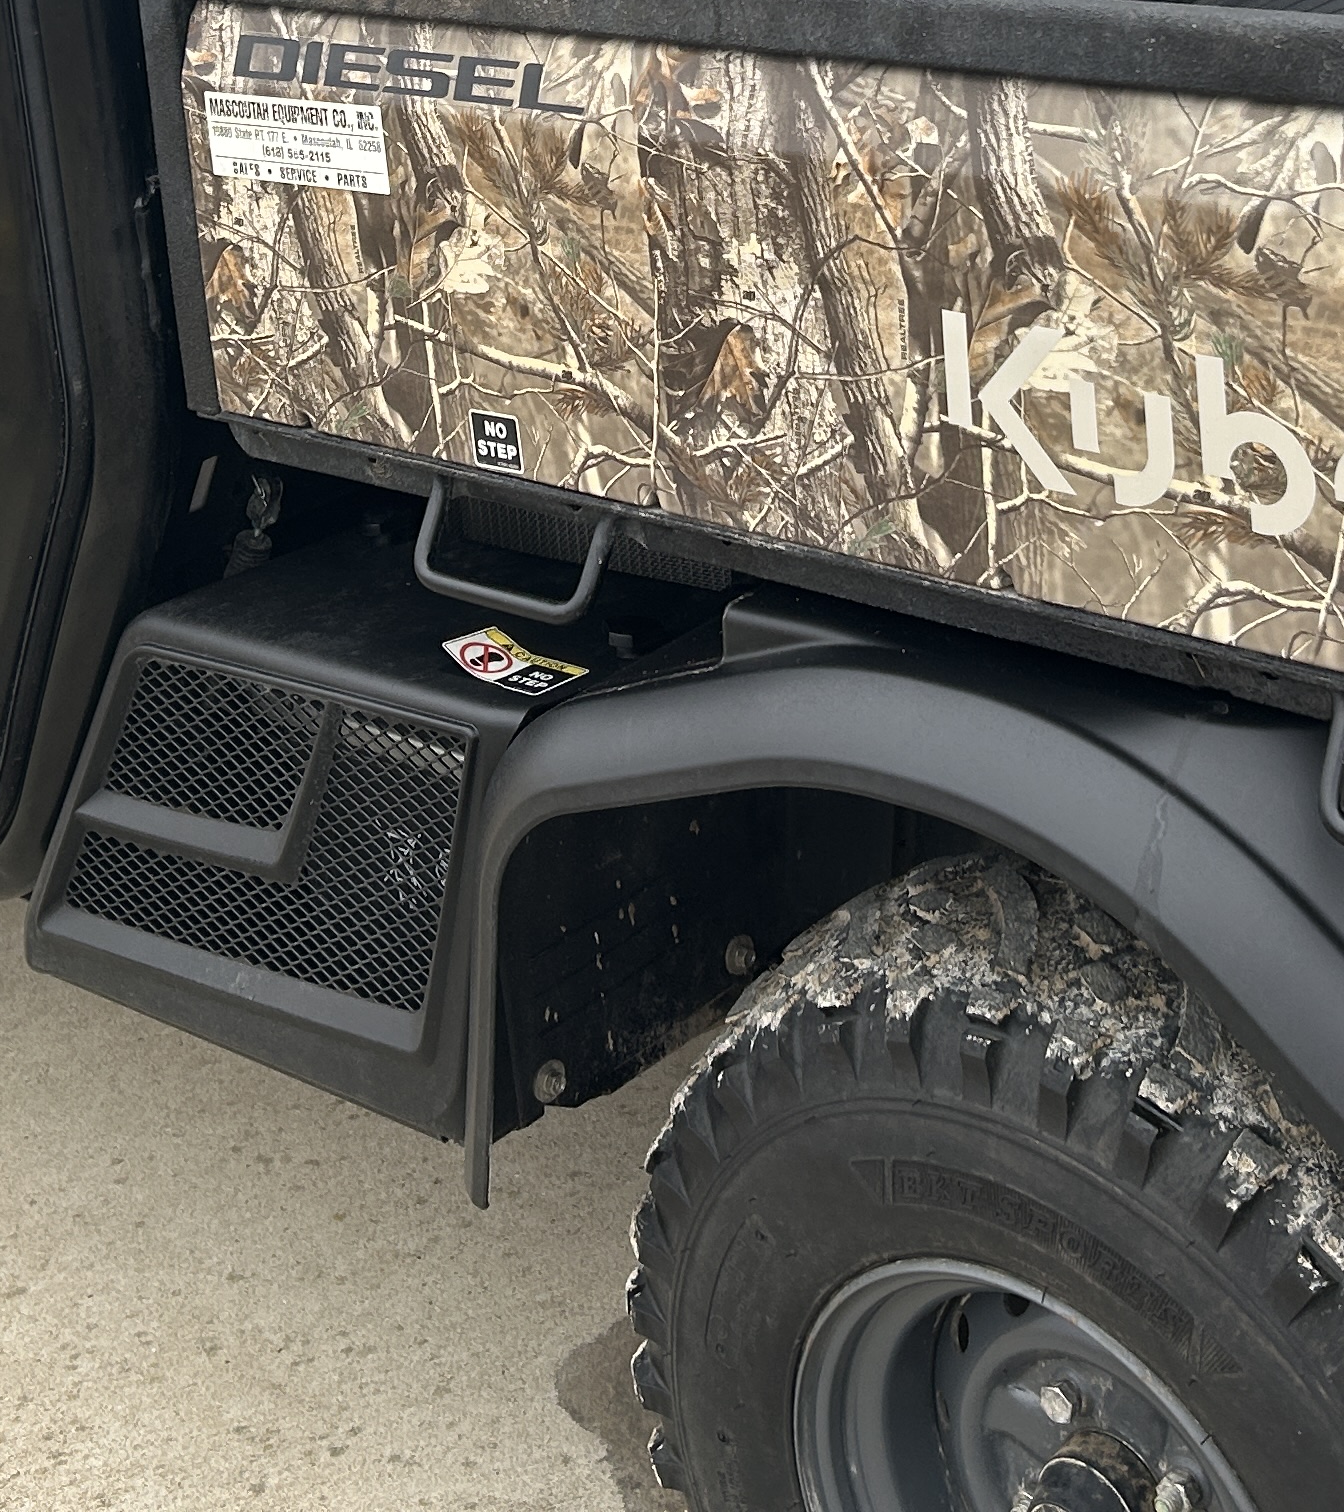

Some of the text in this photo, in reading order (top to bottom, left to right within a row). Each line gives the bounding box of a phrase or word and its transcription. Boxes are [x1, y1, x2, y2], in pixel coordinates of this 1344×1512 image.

[233, 34, 585, 116] DIESEL
[209, 97, 269, 121] MASCOUTAH
[272, 103, 329, 127] EQUIPMENT
[232, 161, 368, 188] SALES SERVICE PARTS
[897, 298, 907, 360] REALTREE
[483, 419, 507, 439] NO
[477, 439, 517, 461] STEP
[515, 651, 567, 670] CAUTION
[508, 674, 548, 688] STEP
[528, 670, 554, 682] NO
